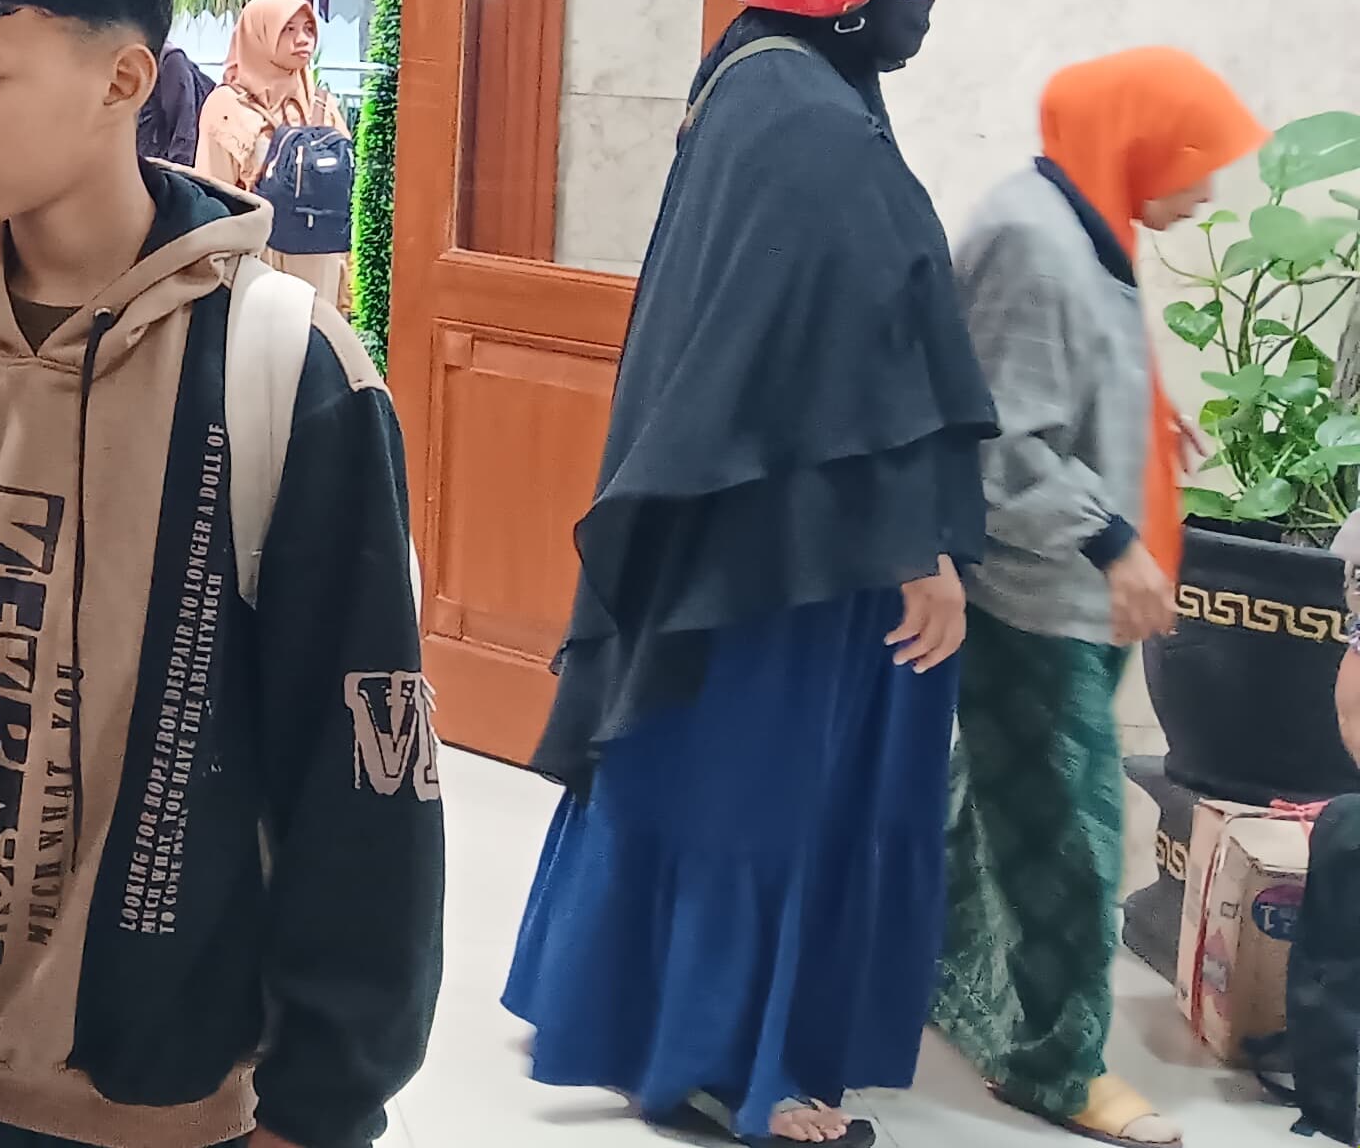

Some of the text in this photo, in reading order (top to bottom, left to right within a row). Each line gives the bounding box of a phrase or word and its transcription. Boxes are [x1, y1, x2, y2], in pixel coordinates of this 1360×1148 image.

[119, 422, 225, 931] LOOKING FOR HOPE FROM DESPAIR NO LONGER A DOLL OF
[180, 699, 203, 734] THE
[171, 738, 197, 785] HAVE
[28, 662, 84, 946] MUCH WHAT YOU
[161, 788, 185, 823] YOU
[141, 887, 162, 934] MUCH
[159, 910, 176, 935] TO
